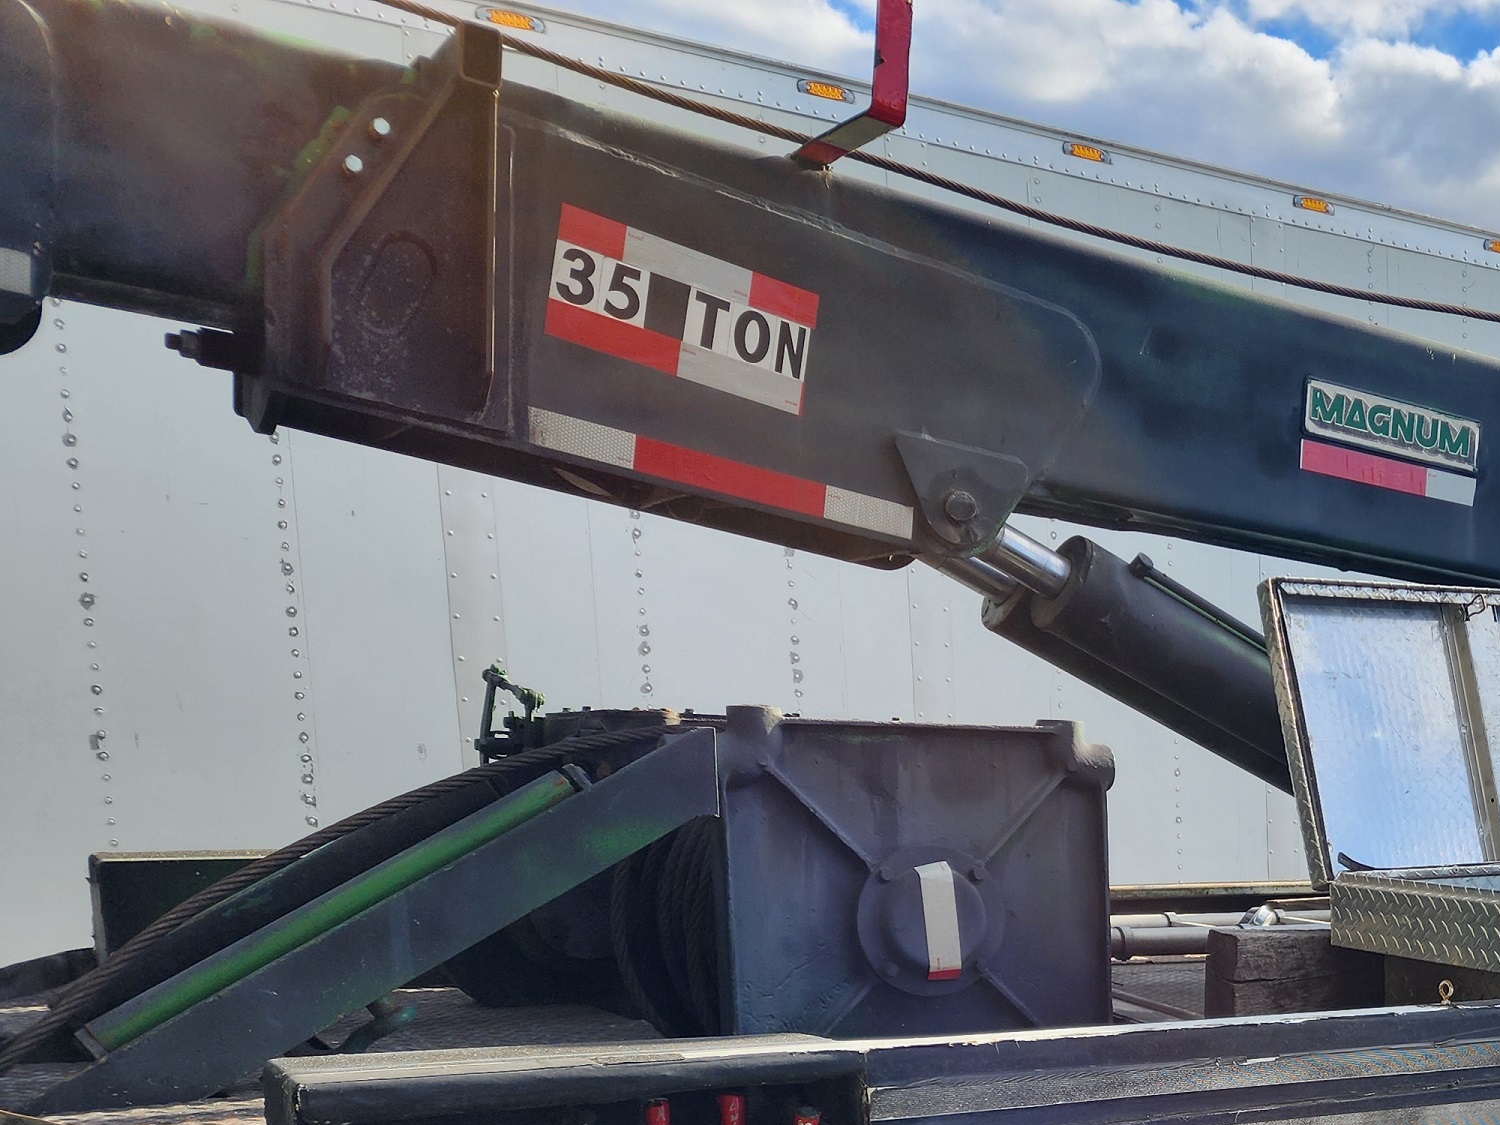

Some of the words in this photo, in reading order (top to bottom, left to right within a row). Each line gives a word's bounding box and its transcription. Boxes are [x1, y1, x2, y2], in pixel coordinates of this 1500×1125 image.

[555, 248, 642, 321] 35
[694, 289, 807, 381] TON
[1309, 385, 1474, 460] MAGNUM
